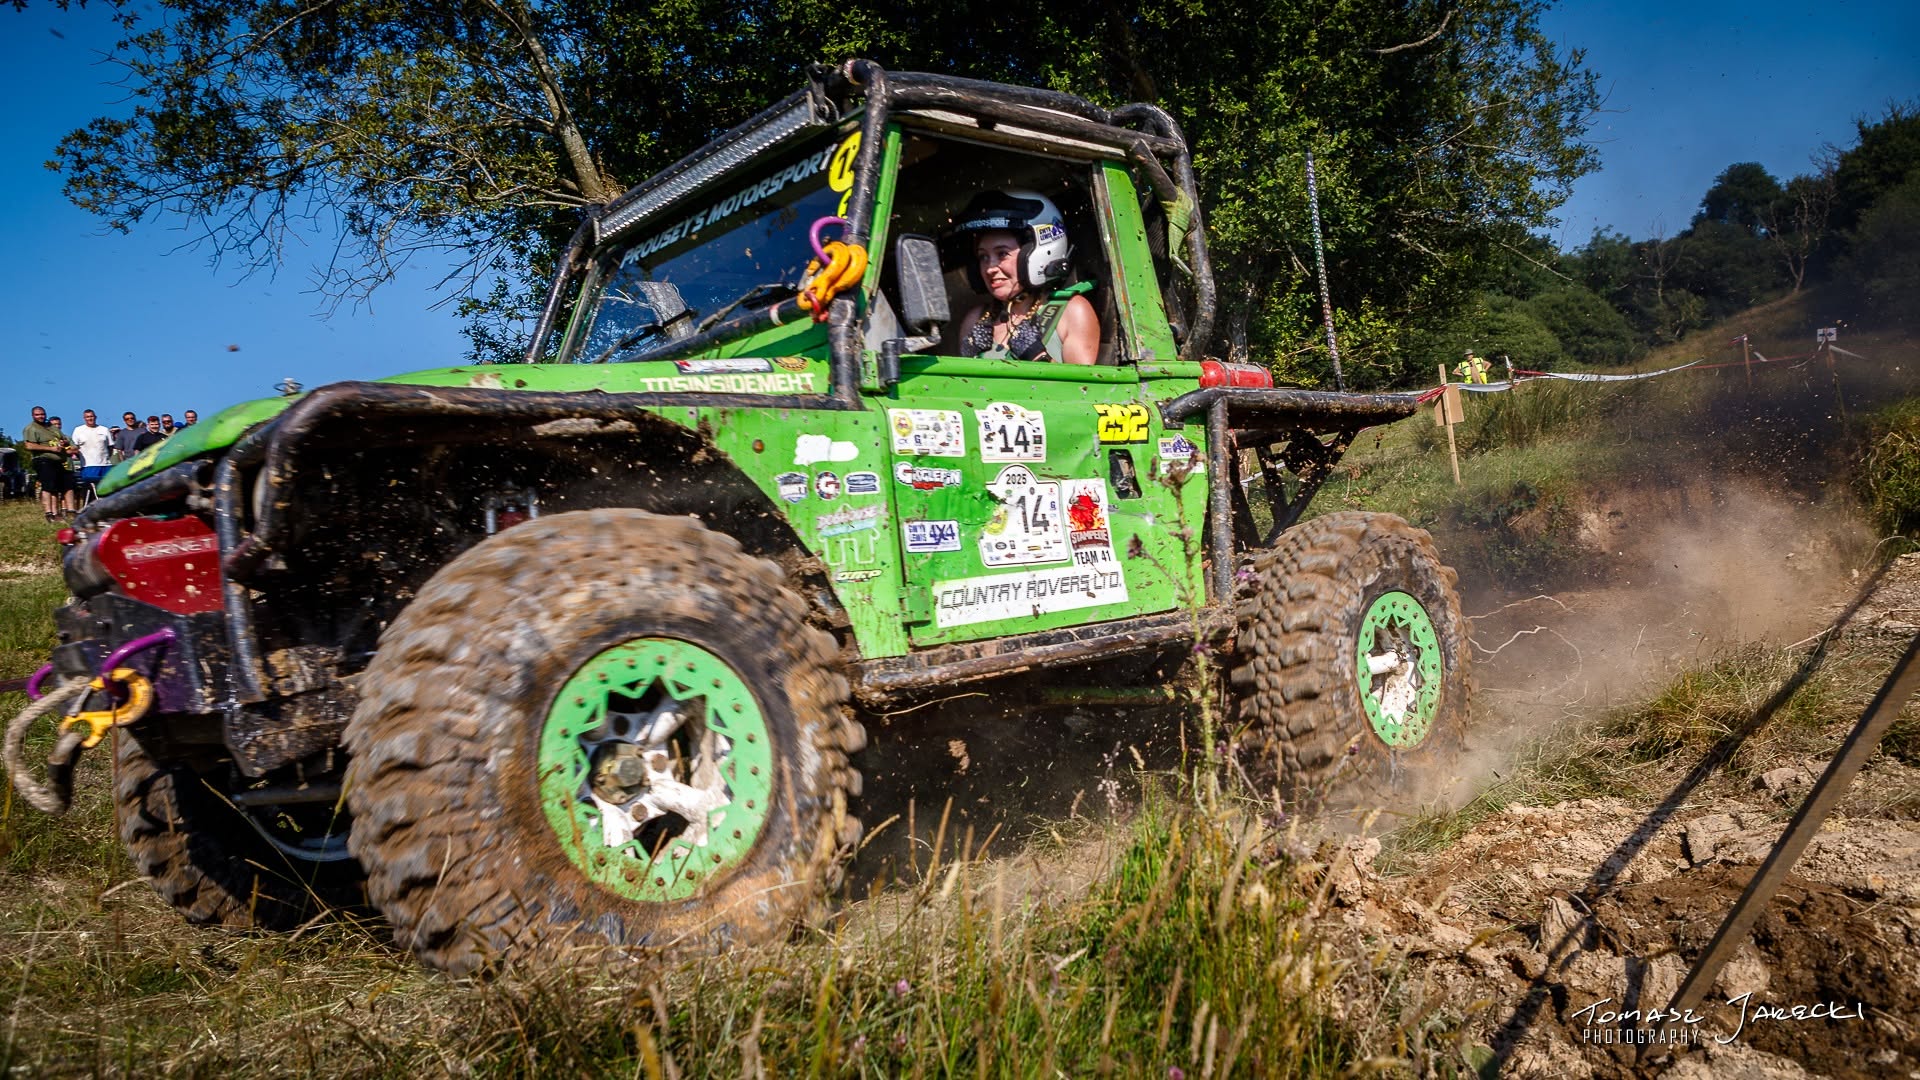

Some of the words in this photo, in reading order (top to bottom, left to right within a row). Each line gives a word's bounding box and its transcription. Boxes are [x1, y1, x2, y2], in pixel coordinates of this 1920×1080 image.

[620, 207, 709, 270] PROUSEY'S
[706, 143, 838, 226] MOTORSPORT
[998, 424, 1030, 453] 14
[1006, 473, 1027, 485] 2025
[1017, 494, 1050, 534] 14
[1071, 529, 1109, 544] STAMPEDE
[1074, 550, 1099, 565] TEAM
[1101, 550, 1112, 562] 41
[940, 582, 1023, 609] COUNTRY
[1026, 574, 1090, 599] ROVERS
